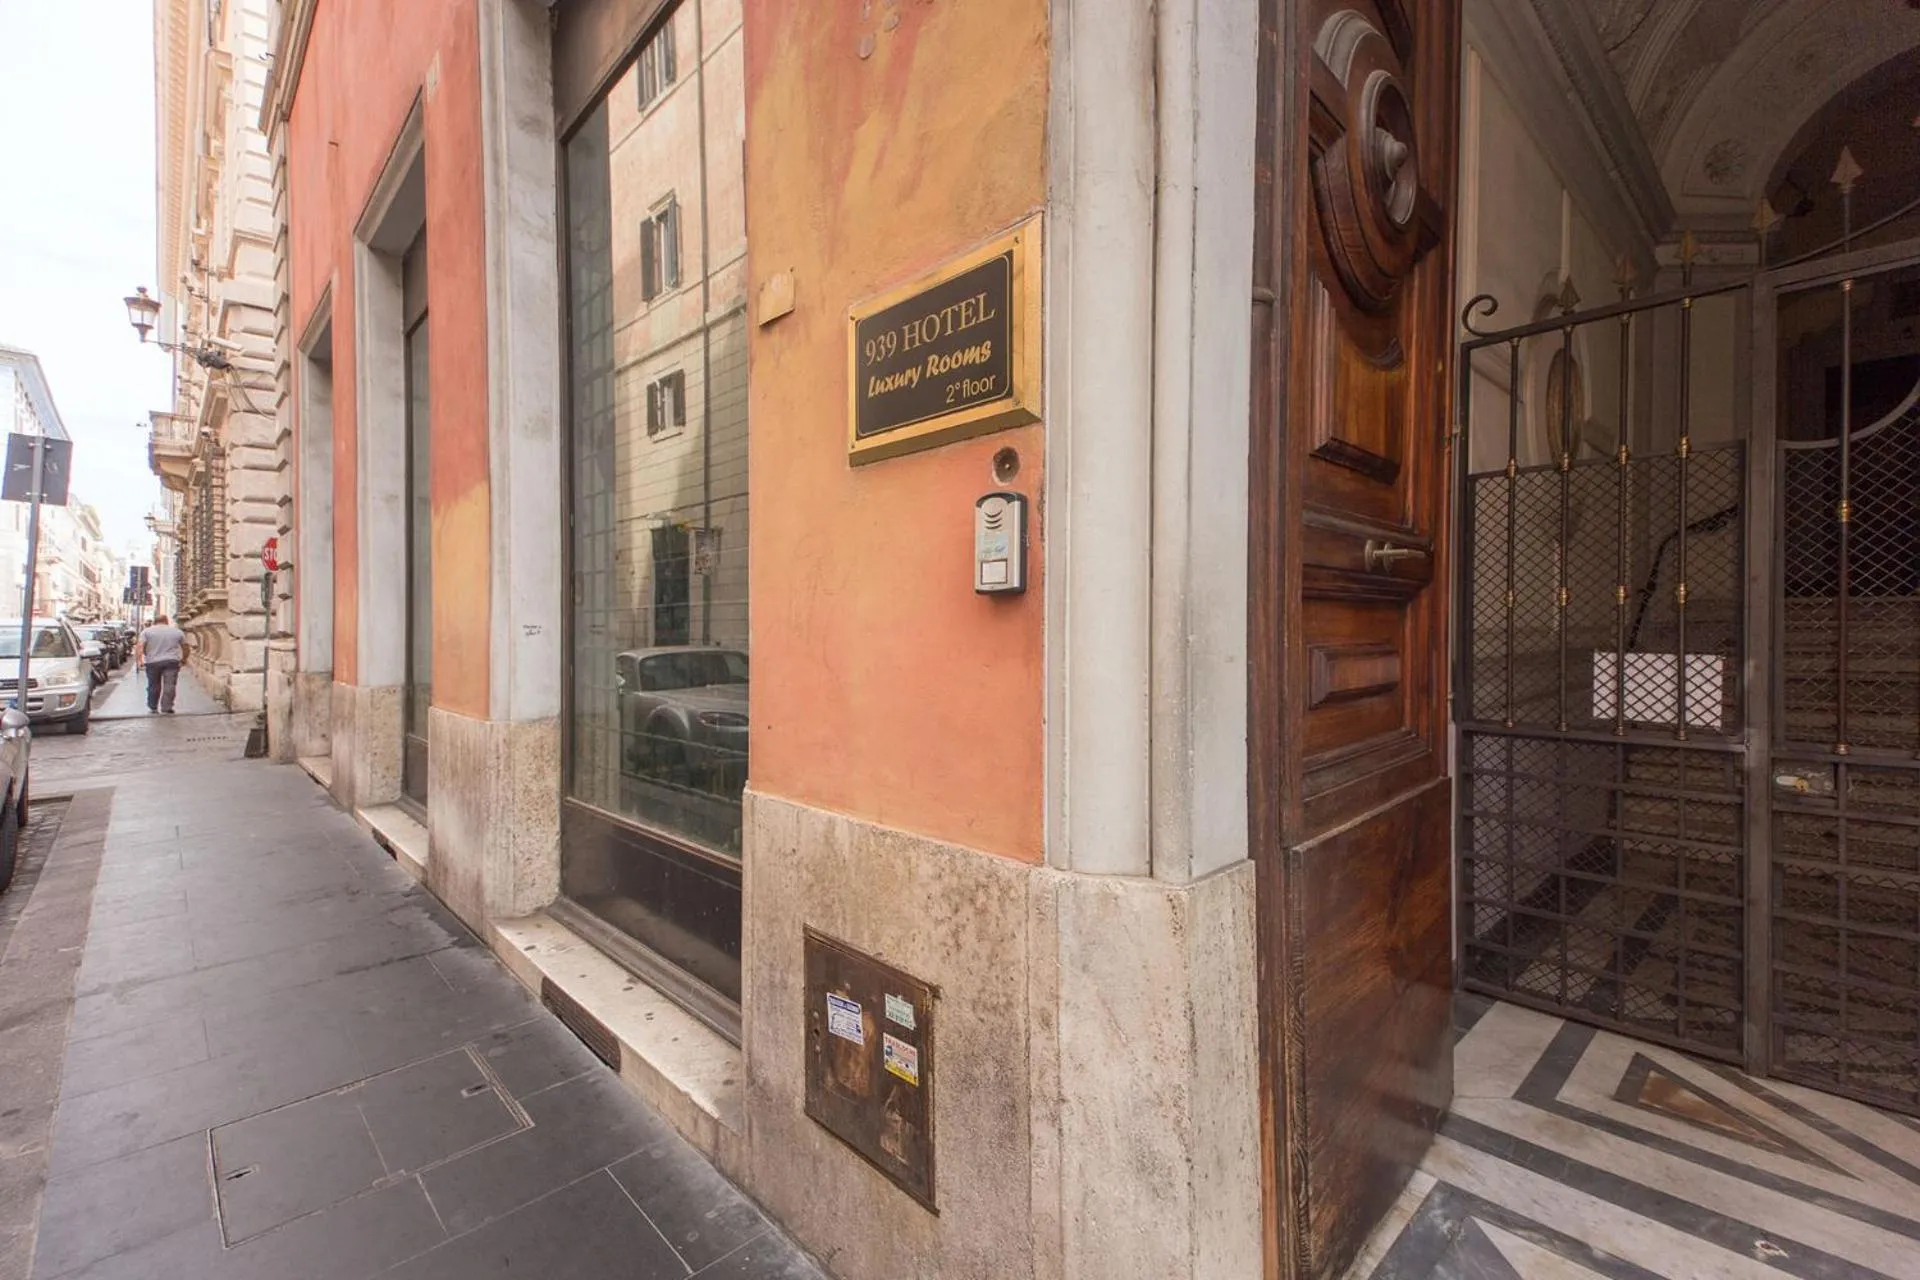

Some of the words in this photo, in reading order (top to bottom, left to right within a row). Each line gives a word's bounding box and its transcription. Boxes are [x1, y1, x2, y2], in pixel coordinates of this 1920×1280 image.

[865, 331, 896, 366] 939
[902, 293, 995, 352] HOTEL
[868, 365, 921, 397] Luxury
[962, 374, 996, 398] floor
[265, 548, 277, 561] STO
